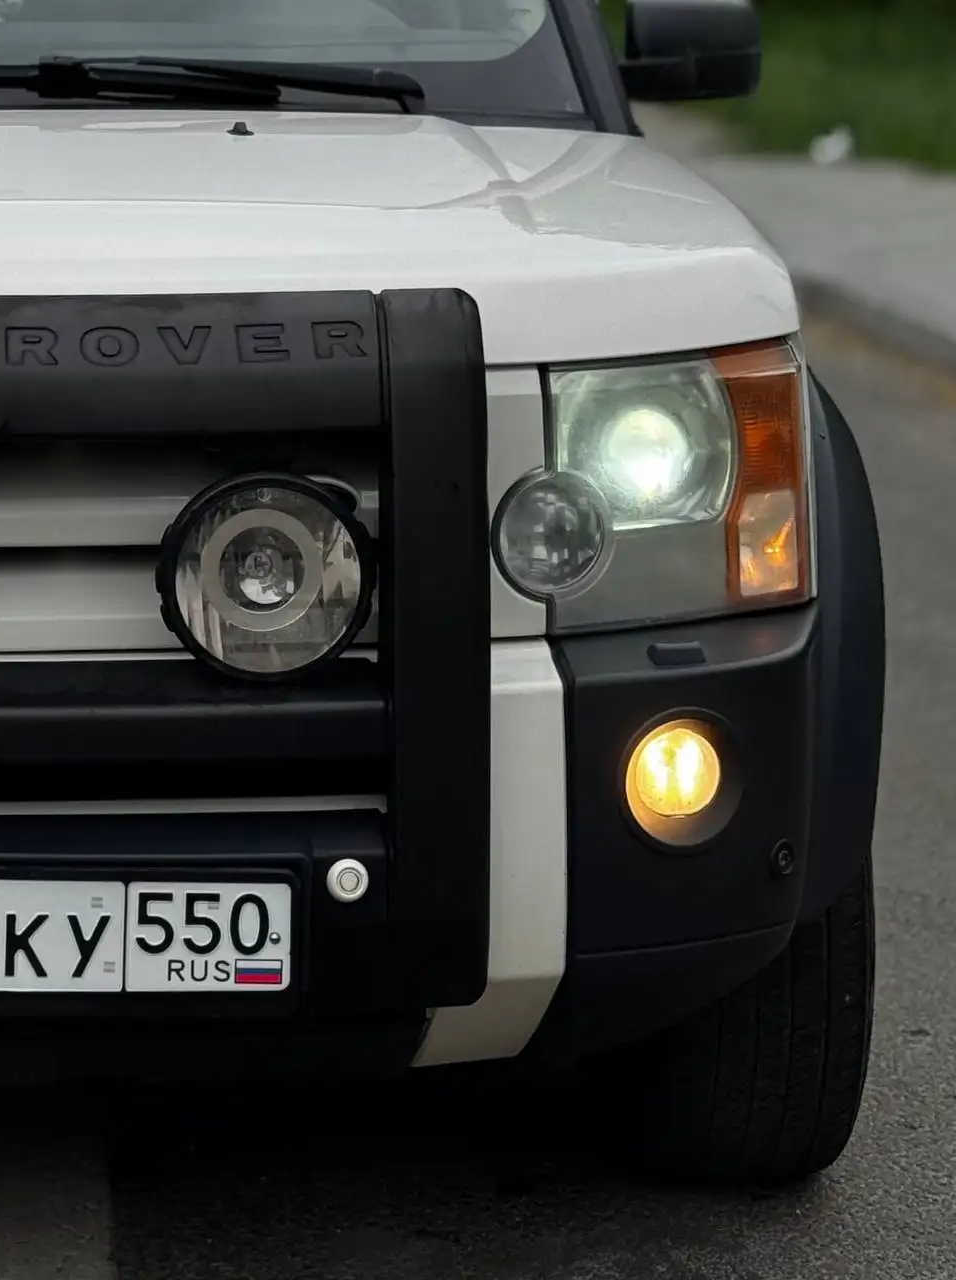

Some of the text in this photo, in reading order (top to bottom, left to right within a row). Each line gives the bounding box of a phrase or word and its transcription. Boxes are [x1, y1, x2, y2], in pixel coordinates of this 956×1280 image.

[4, 319, 369, 367] ROVER
[134, 891, 271, 956] 550
[167, 960, 232, 983] RUS
